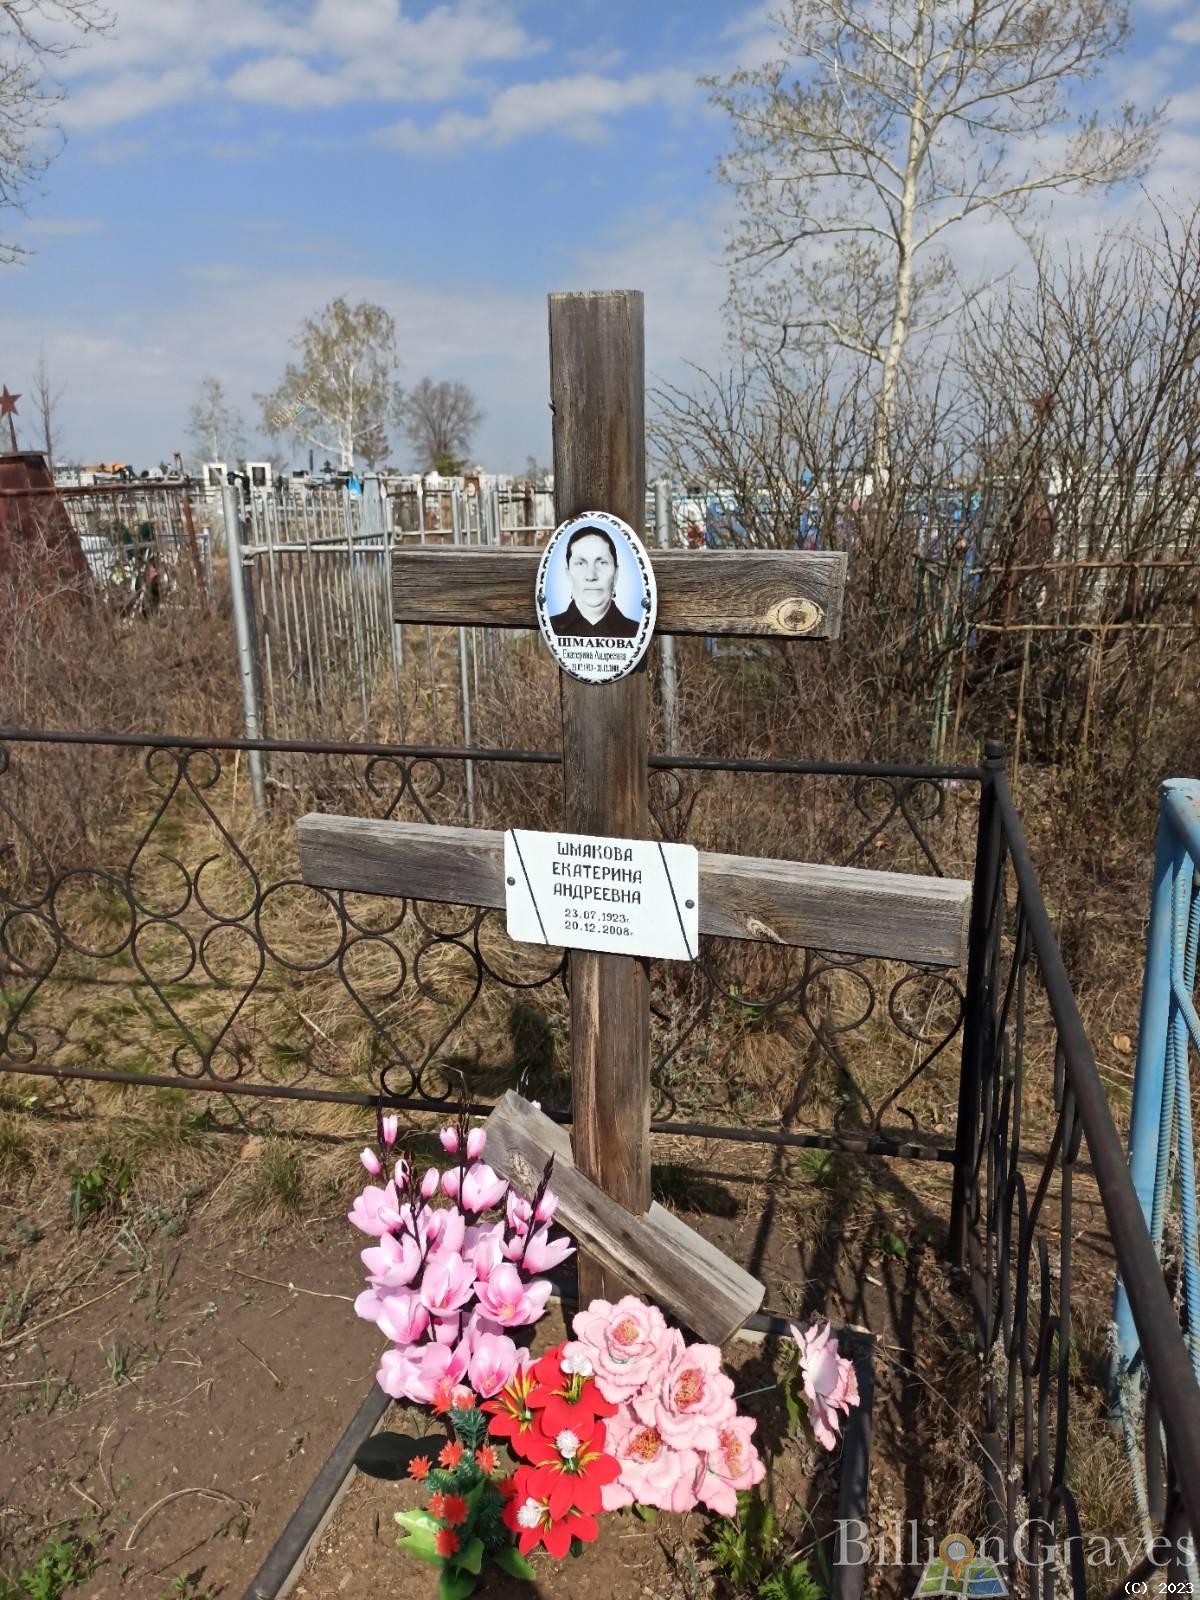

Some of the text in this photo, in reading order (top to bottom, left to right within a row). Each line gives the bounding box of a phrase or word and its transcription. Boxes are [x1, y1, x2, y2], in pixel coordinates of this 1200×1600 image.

[557, 637, 635, 649] ШМАКОВА
[557, 841, 633, 862] ШМАКОВА
[552, 861, 642, 885] ЕКАТЕРИНА
[553, 882, 641, 905] АНДРЕЕВНА
